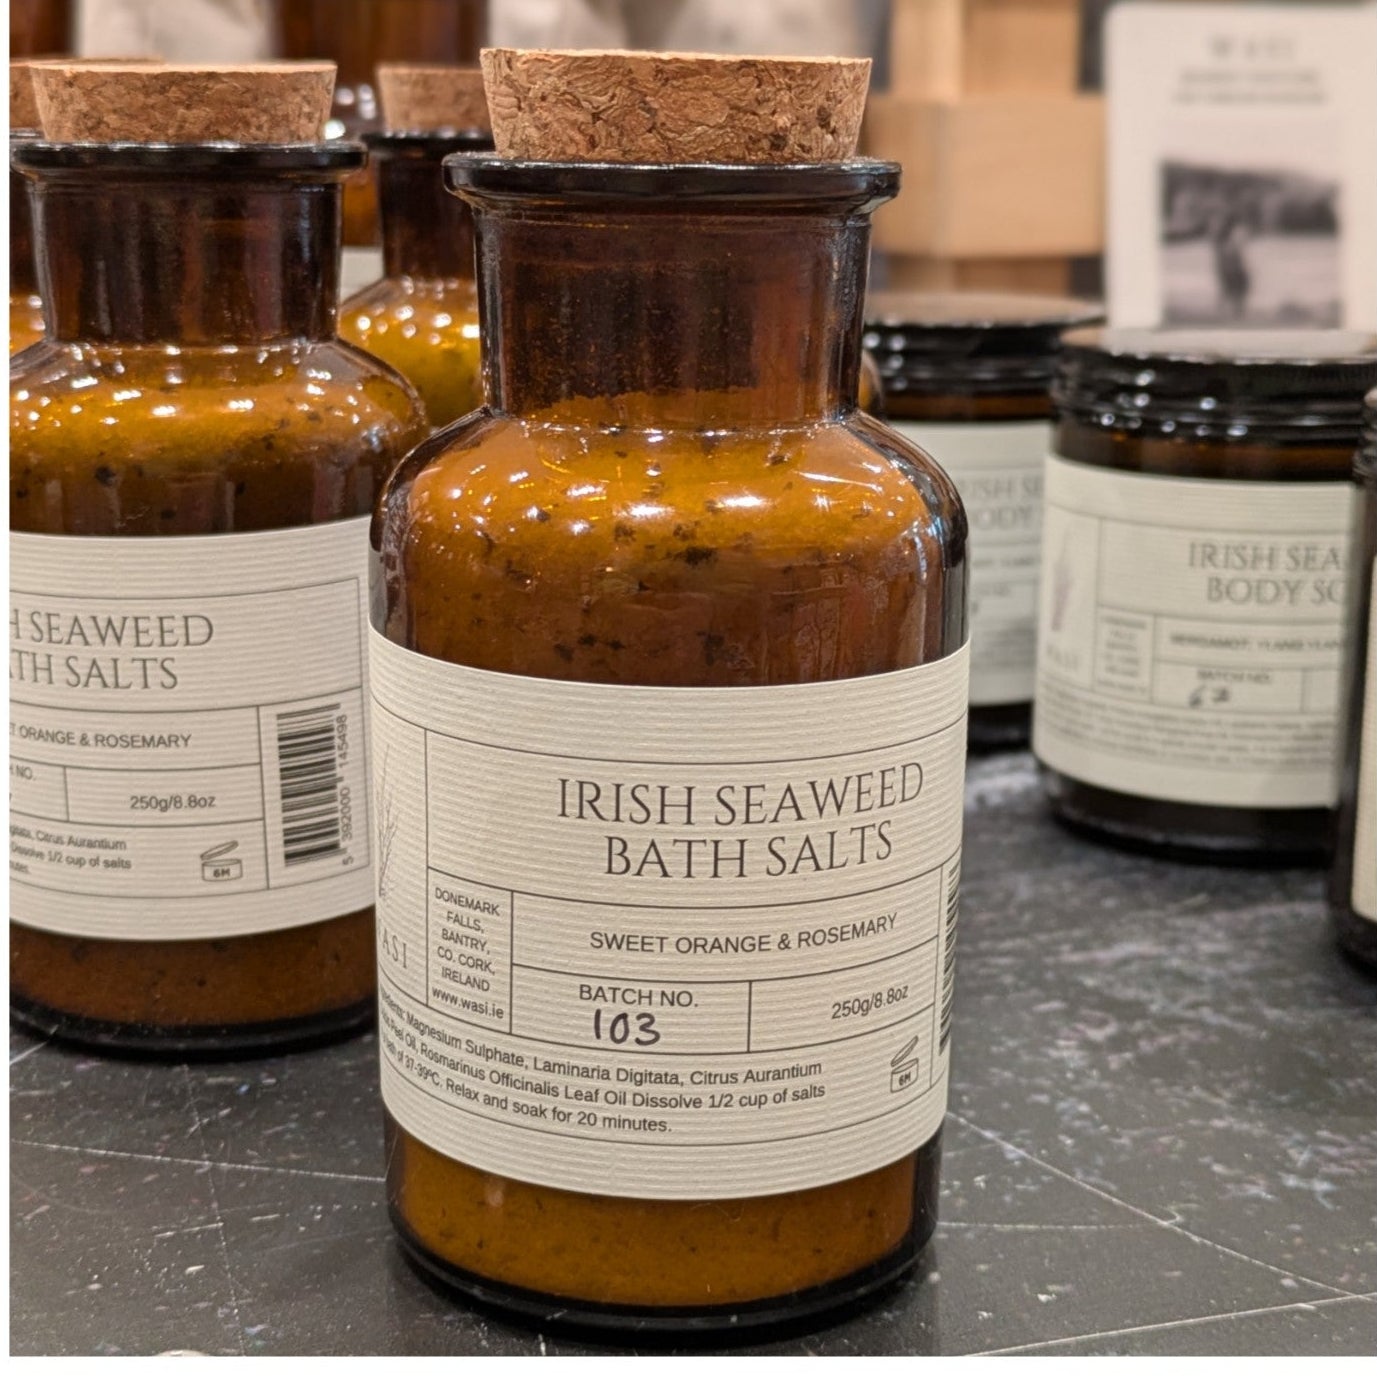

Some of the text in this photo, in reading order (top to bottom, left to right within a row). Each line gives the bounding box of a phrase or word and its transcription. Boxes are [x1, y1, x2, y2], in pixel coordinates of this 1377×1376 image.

[1188, 541, 1342, 572] IRISH SEA
[1207, 575, 1303, 605] BODY
[30, 610, 214, 648] SEAWEED
[65, 655, 179, 690] SALTS
[19, 724, 76, 746] ORANGE
[79, 733, 92, 747] &
[94, 733, 193, 749] ROSEMARY
[335, 713, 350, 769] 145498
[129, 794, 217, 813] 250g/8.8oz
[557, 761, 925, 827] IRISH SEAWEED
[339, 786, 354, 843] 392000
[604, 820, 893, 879] BATH SALTS
[434, 887, 501, 917] DONEMARK
[446, 911, 485, 934] FALLS,
[589, 912, 899, 955] SWEET ORANGE & ROSEMARY
[378, 922, 408, 969] ASI
[441, 928, 491, 955] BANTRY,
[436, 945, 497, 977] CO. CORK,
[441, 966, 491, 993] IRELAND
[579, 983, 700, 1008] BATCH NO.
[431, 986, 505, 1020] www.wasi.ie
[830, 984, 910, 1020] 250g/8.8oz
[593, 1008, 662, 1047] 103
[406, 1011, 462, 1050] Magnesium
[464, 1039, 529, 1070] Sulphate,
[532, 1056, 611, 1081] Laminaria
[615, 1066, 685, 1087] Digitata,
[689, 1069, 739, 1086] Citrus
[742, 1061, 823, 1084] Aurantium
[420, 1042, 486, 1081] Rosmarinus
[488, 1069, 561, 1099] Officinalis
[564, 1083, 600, 1103] Leaf
[603, 1088, 627, 1106] Oil
[632, 1092, 704, 1109] Dissolve
[707, 1093, 734, 1109] 1/2
[738, 1092, 768, 1110] cup
[772, 1088, 788, 1105] of
[790, 1083, 826, 1104] salts
[445, 1077, 480, 1102] Relax
[482, 1091, 509, 1111] and
[512, 1098, 548, 1120] soak
[551, 1106, 573, 1124] for
[577, 1109, 599, 1128] 20
[601, 1113, 673, 1133] minutes.
